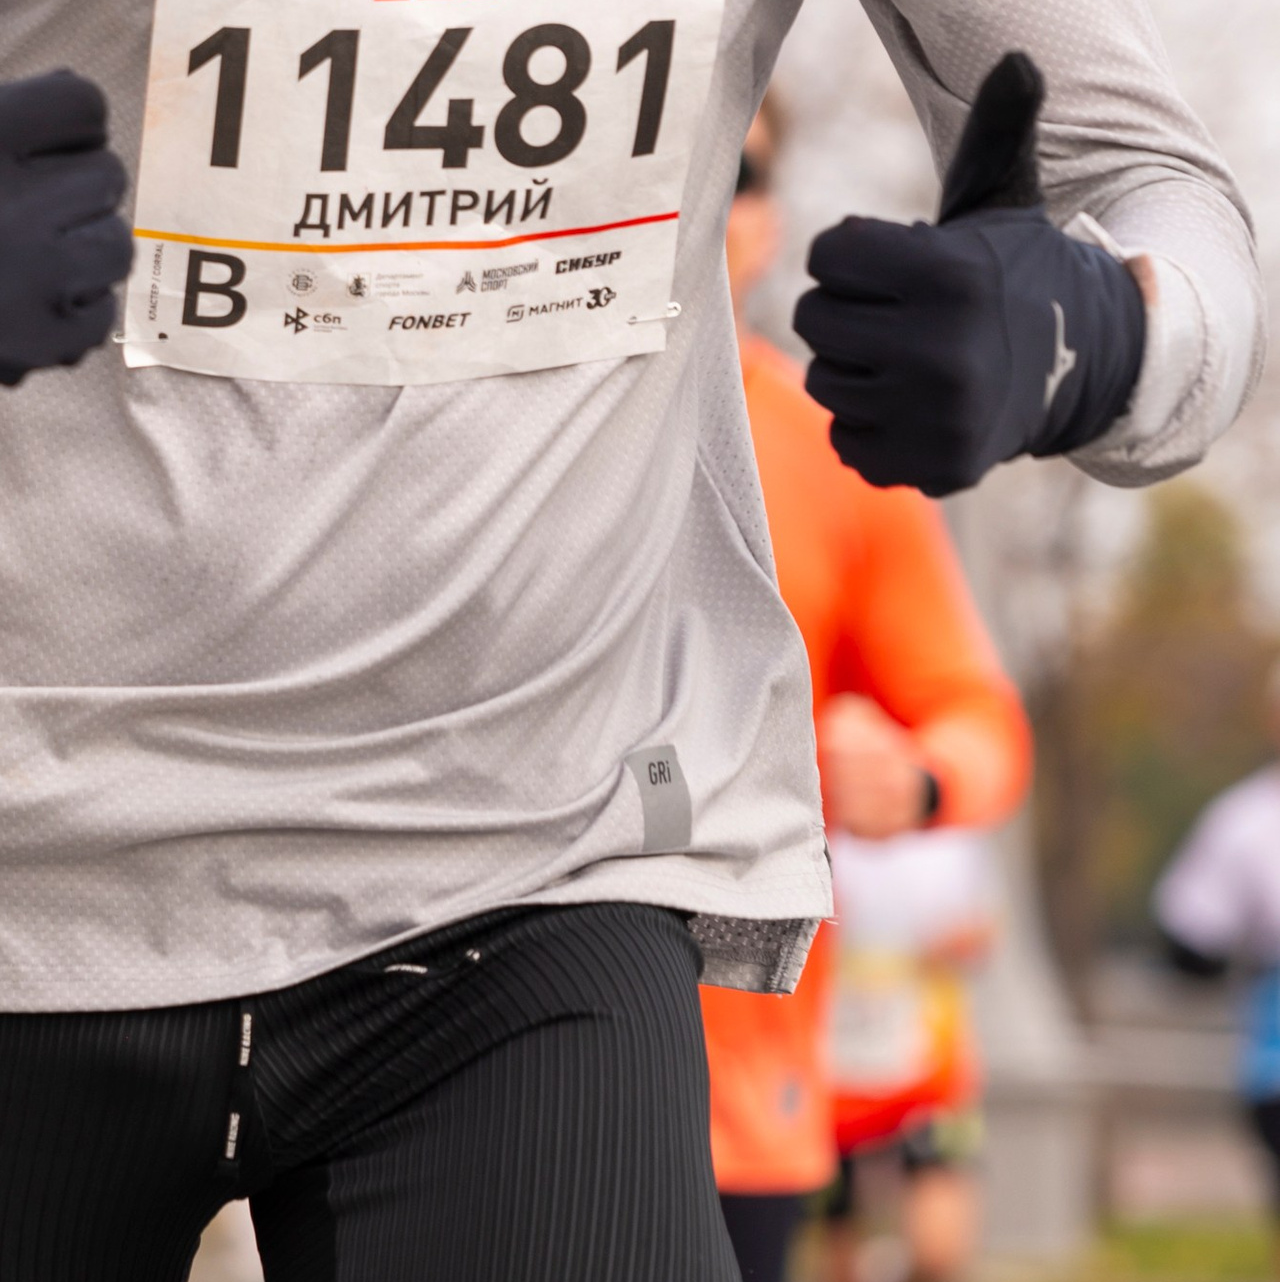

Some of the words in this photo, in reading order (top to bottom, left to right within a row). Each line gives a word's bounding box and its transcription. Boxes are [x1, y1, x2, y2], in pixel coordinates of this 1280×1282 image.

[187, 19, 676, 172] 11481
[293, 178, 554, 238] ДМИТРИЙ
[153, 243, 164, 277] CORRAL
[482, 259, 539, 280] МОСКОВСКИЙ
[555, 251, 622, 275] СИБУР
[480, 279, 508, 293] СПОРТ
[528, 297, 583, 317] МАГНИТ
[388, 312, 471, 331] FONBET
